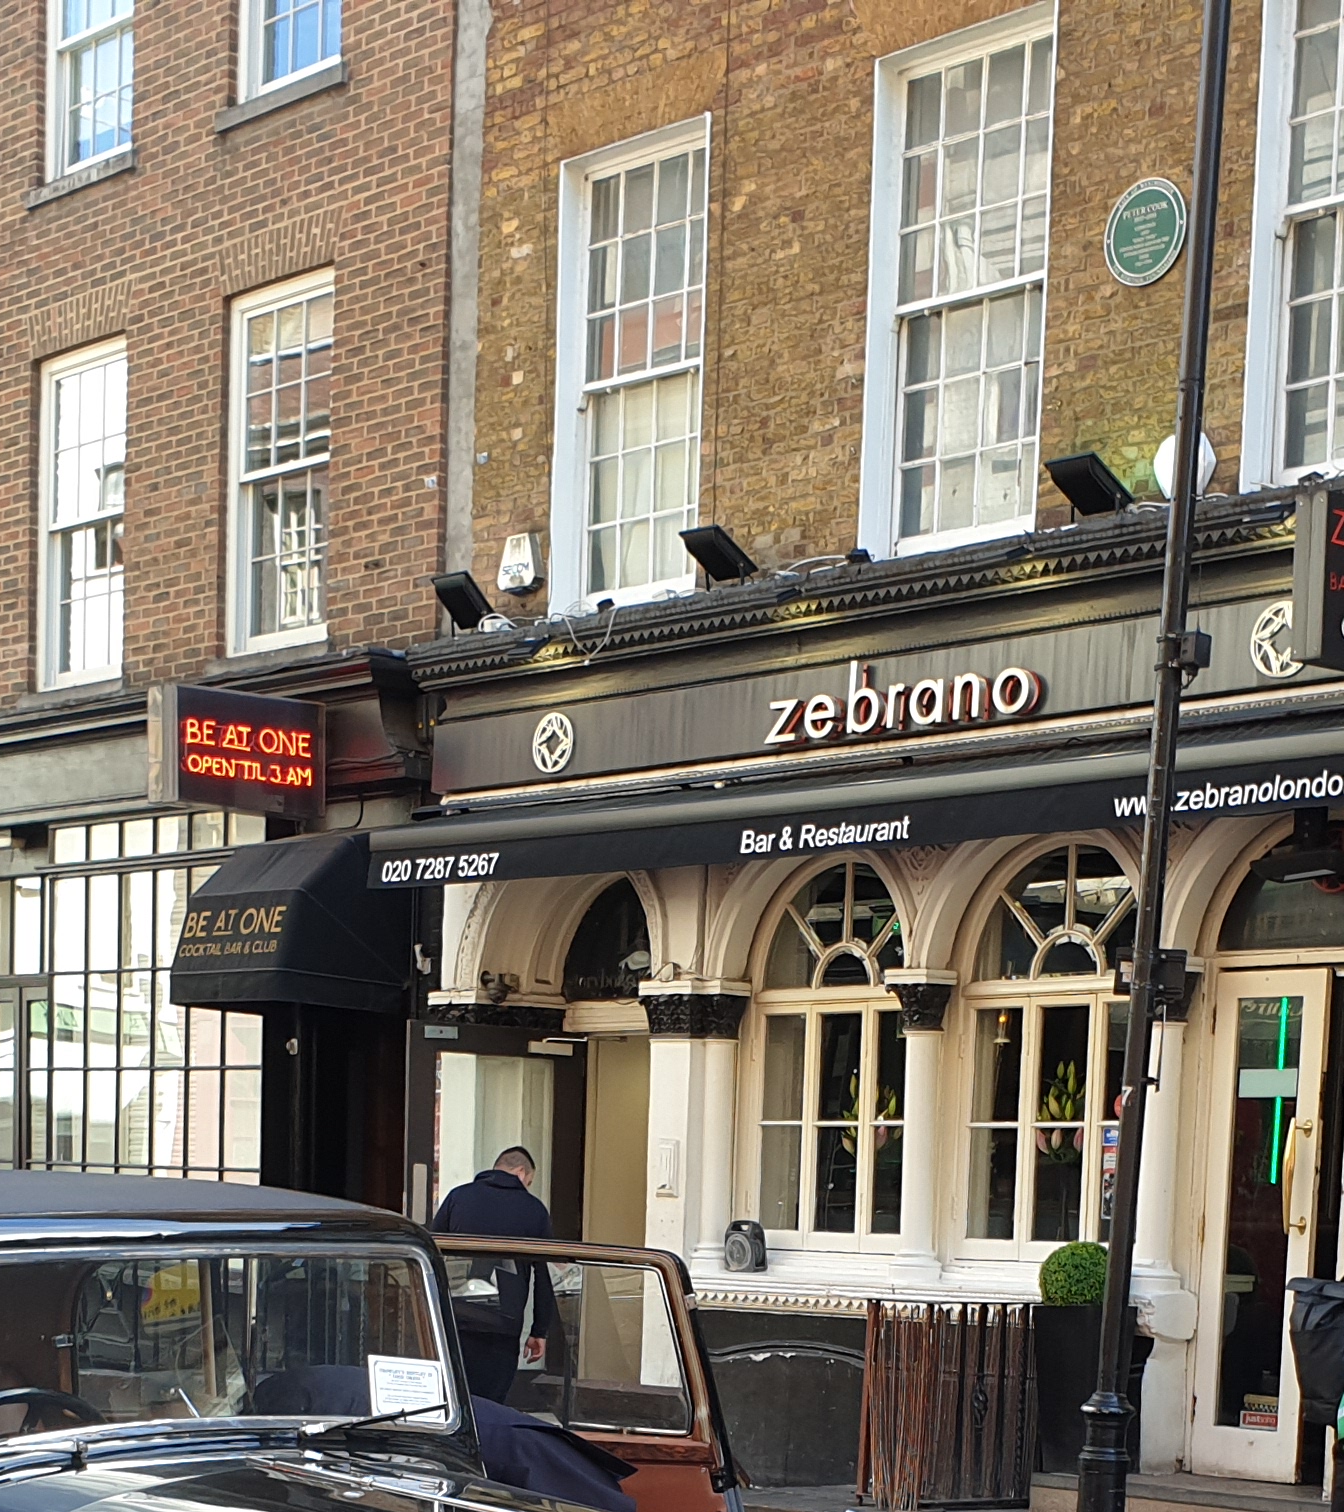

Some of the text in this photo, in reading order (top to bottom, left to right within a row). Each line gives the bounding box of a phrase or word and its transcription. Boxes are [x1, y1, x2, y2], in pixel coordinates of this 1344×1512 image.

[763, 660, 1034, 745] zebrano
[186, 718, 312, 758] BE AT ONE
[187, 754, 235, 778] OPEN
[269, 764, 281, 783] 3
[287, 766, 312, 786] AM
[739, 815, 910, 854] Bar & Restaurant
[381, 852, 500, 883] 020 7287 5267
[183, 905, 287, 938] BE AT ONE
[179, 940, 277, 958] COCKTAIL BAR & CLUB
